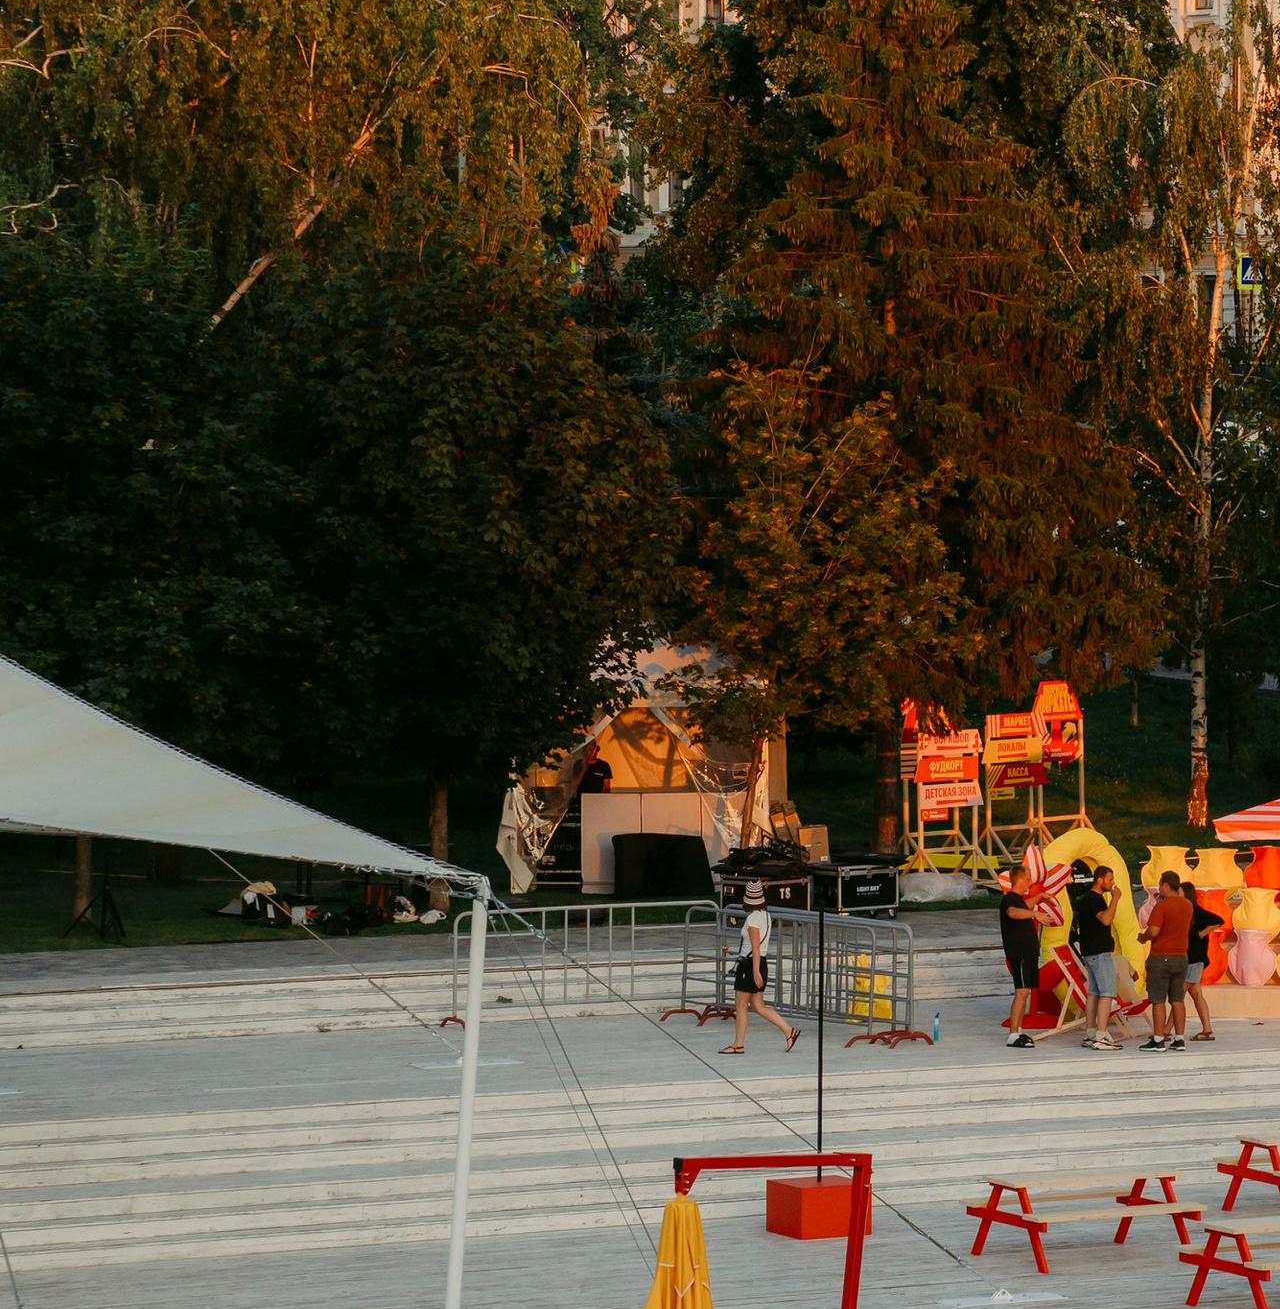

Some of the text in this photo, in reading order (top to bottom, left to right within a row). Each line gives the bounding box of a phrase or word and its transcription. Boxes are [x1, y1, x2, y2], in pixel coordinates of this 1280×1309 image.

[1003, 716, 1032, 727] МАРКЕТ
[997, 742, 1027, 753] ЛОКАЛЫ
[929, 760, 964, 773] ФУДКОРТ
[1007, 767, 1029, 777] КАССА
[925, 785, 977, 800] ДЕТСКАЯ ЗОНА
[779, 887, 791, 899] TS
